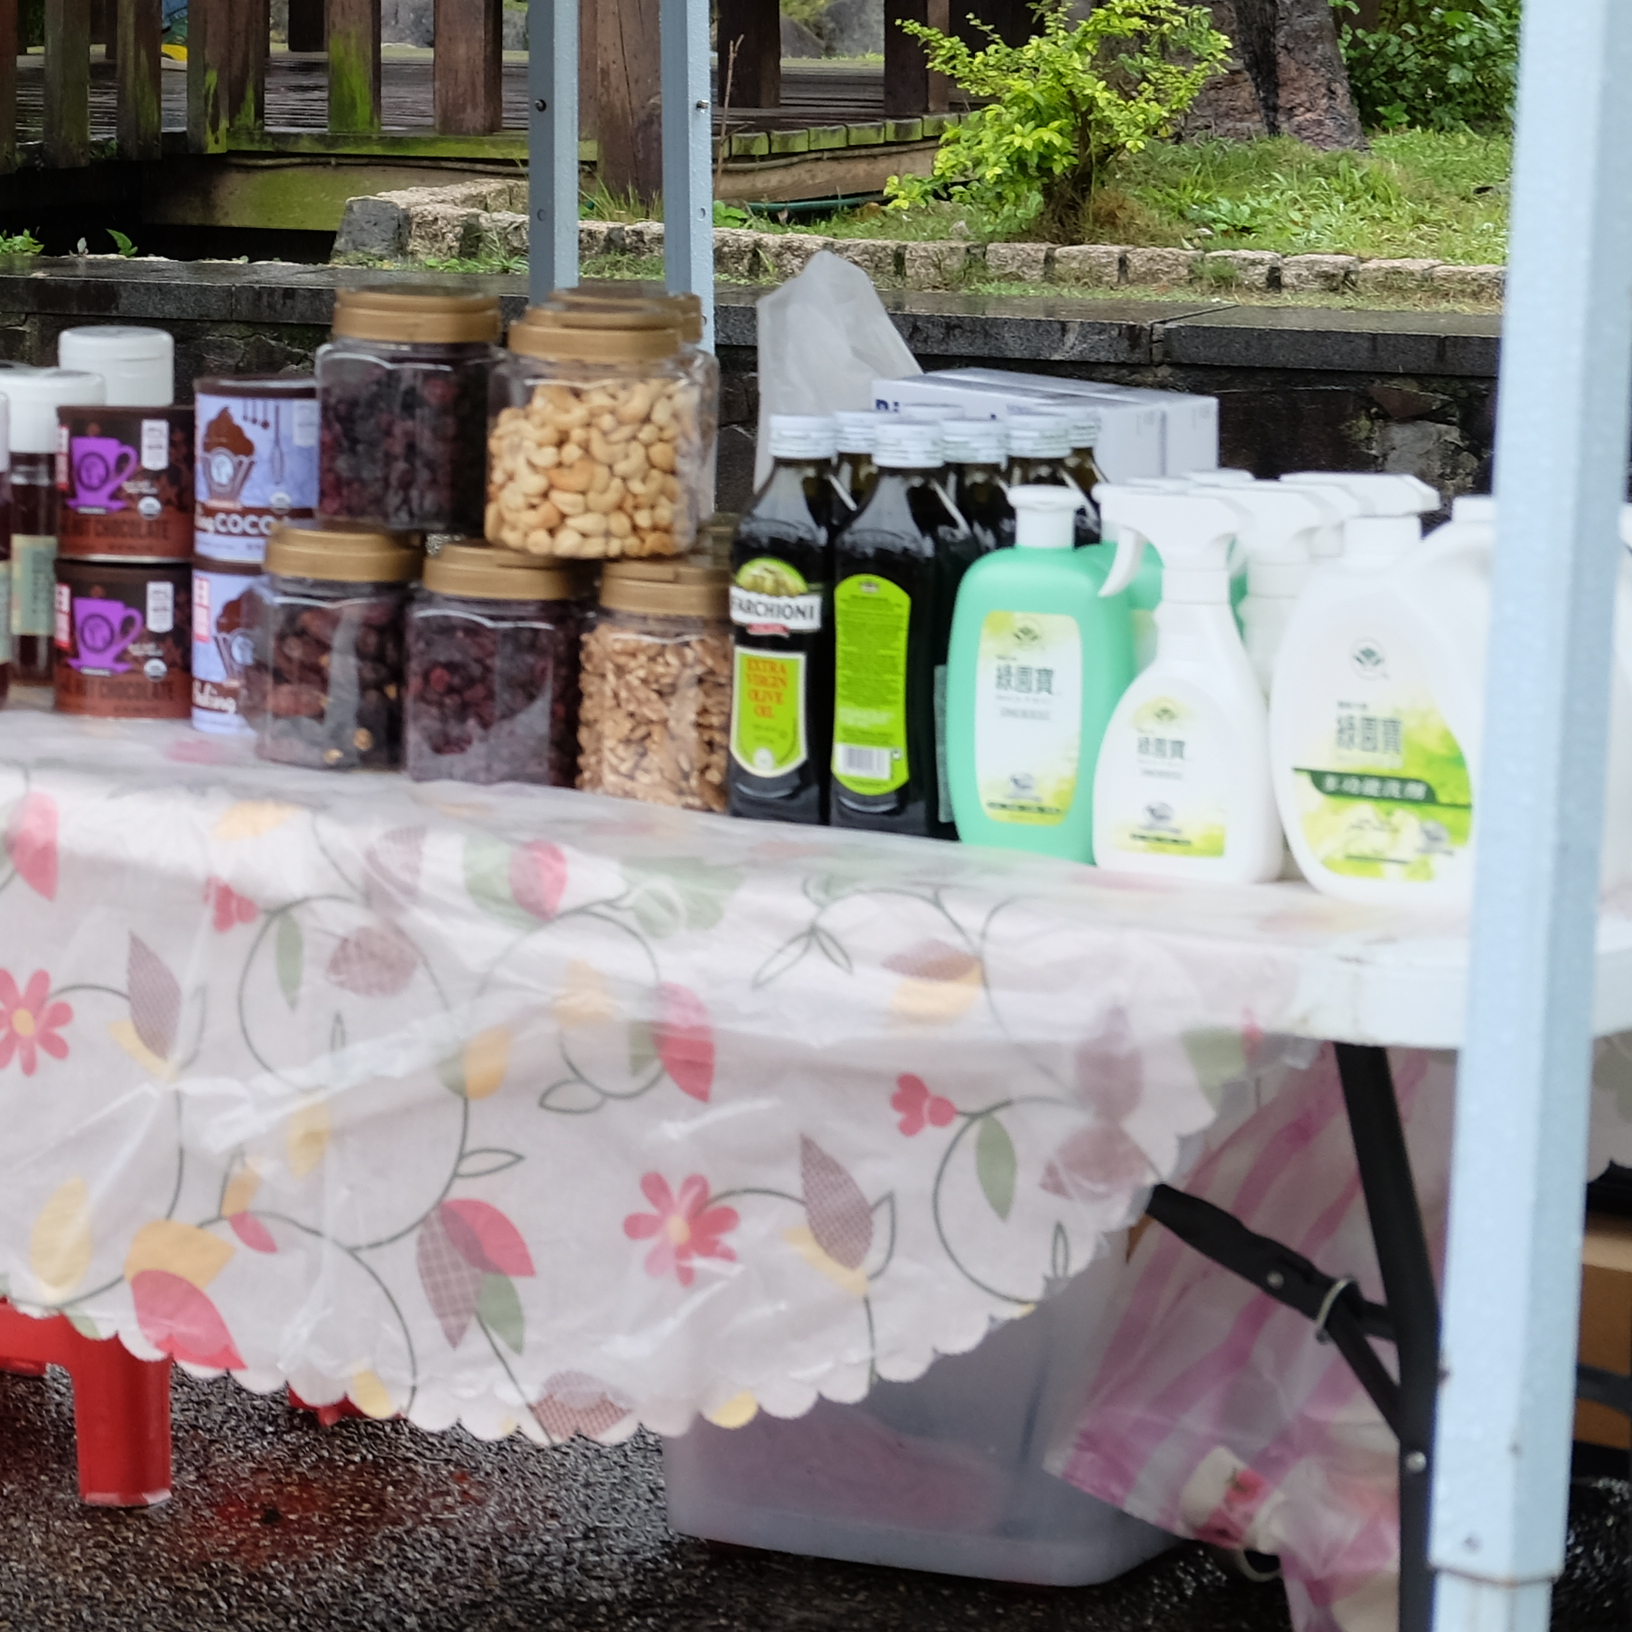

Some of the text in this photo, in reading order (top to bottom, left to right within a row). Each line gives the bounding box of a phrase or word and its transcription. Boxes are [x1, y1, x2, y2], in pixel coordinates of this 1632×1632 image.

[746, 657, 787, 675] EXTRA
[746, 672, 788, 690] VIRGIN
[748, 688, 785, 706] OLIVE
[754, 704, 774, 719] OIL
